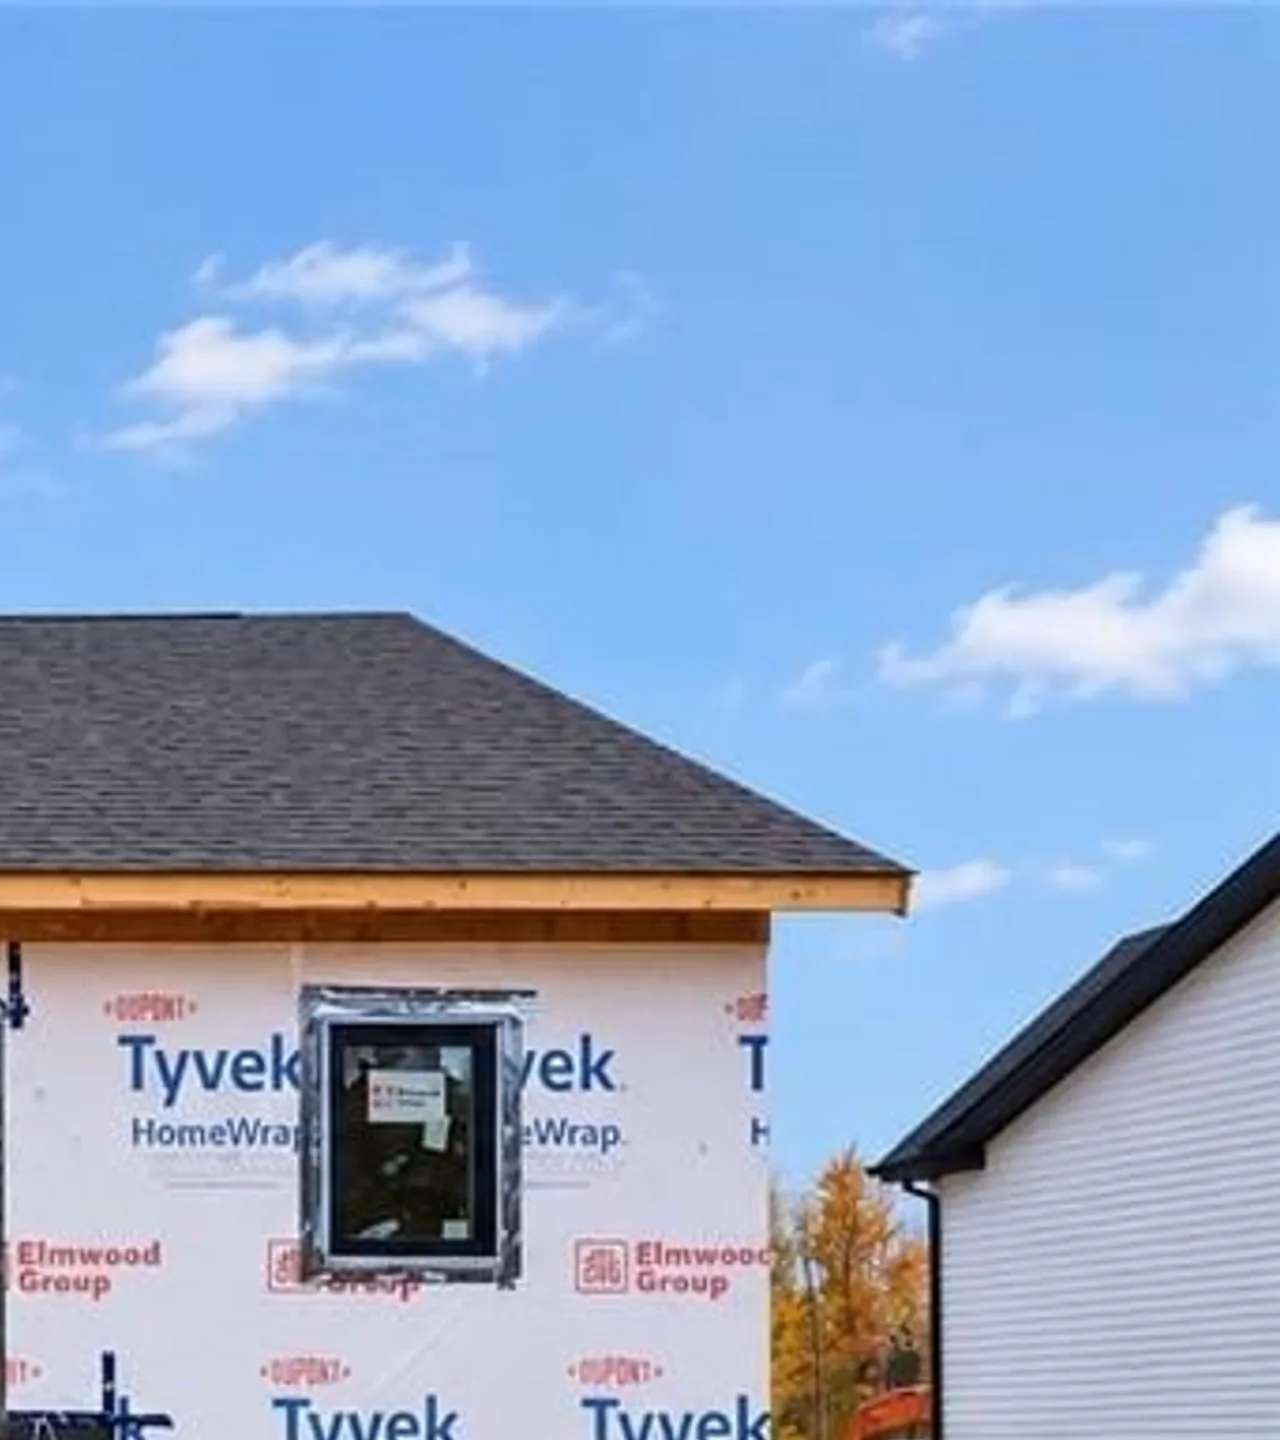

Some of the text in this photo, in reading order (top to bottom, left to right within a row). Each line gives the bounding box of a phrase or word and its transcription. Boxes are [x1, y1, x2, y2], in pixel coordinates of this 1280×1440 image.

[117, 1033, 299, 1108] Tyvek
[17, 1240, 161, 1267] Elmwood
[18, 1270, 111, 1300] Group
[636, 1270, 729, 1300] Group
